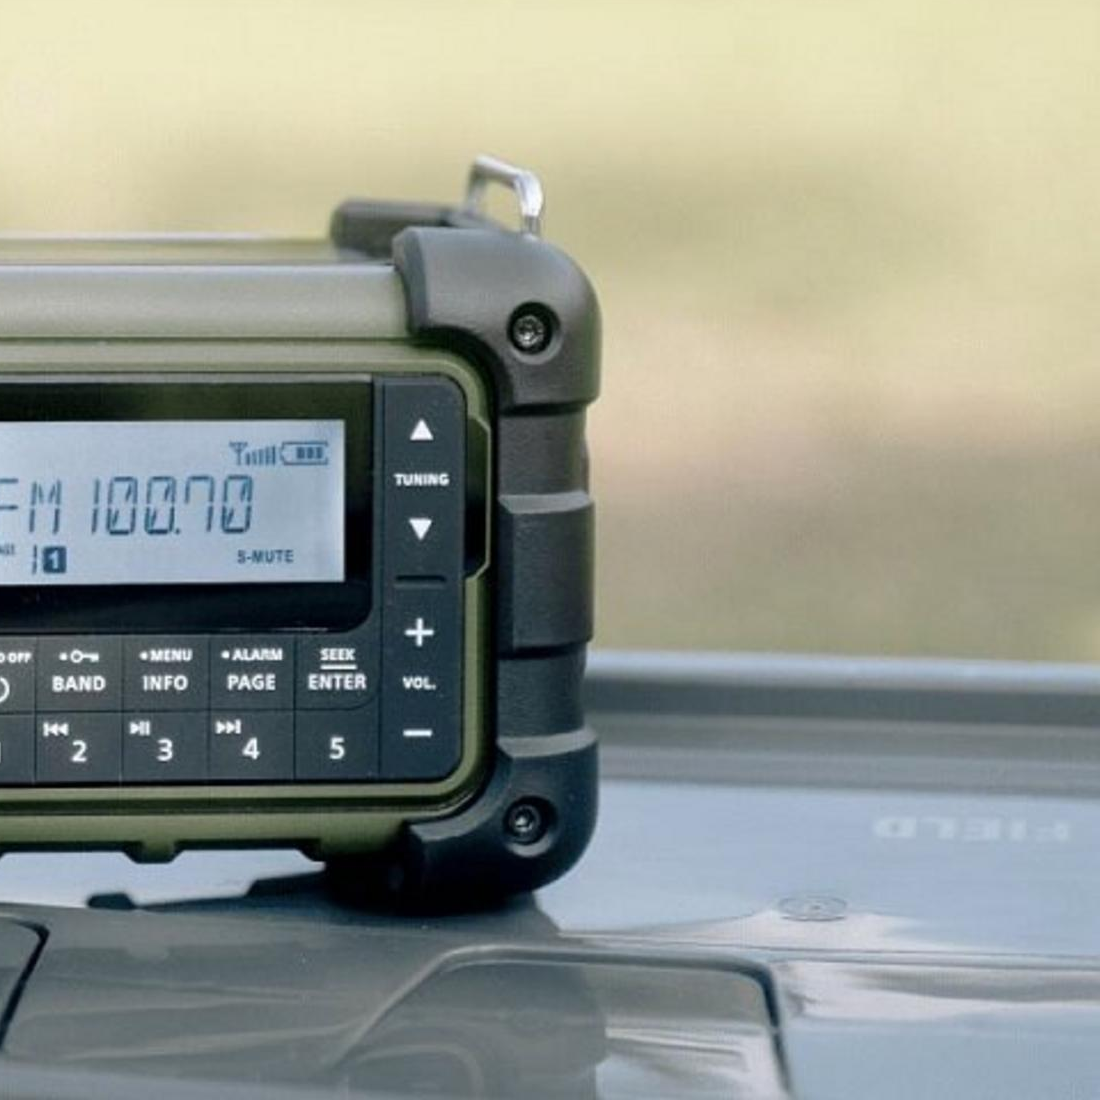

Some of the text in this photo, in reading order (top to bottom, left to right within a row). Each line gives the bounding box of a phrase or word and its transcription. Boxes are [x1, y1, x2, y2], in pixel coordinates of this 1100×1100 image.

[394, 472, 450, 486] TUNING
[90, 474, 254, 535] 100.70
[236, 549, 295, 564] S-MUTE
[7, 651, 32, 663] OFF
[149, 648, 193, 662] MENU
[231, 647, 284, 661] ALARM
[320, 647, 357, 662] SEEK
[51, 675, 106, 692] BAND
[142, 674, 189, 691] INFO
[226, 673, 277, 691] PAGE
[307, 673, 367, 691] ENTER
[402, 676, 437, 690] VOL.
[71, 739, 88, 763] 2
[156, 738, 174, 762] 3
[241, 736, 261, 760] 4
[328, 736, 346, 760] 5
[872, 816, 1071, 842] FIELD
